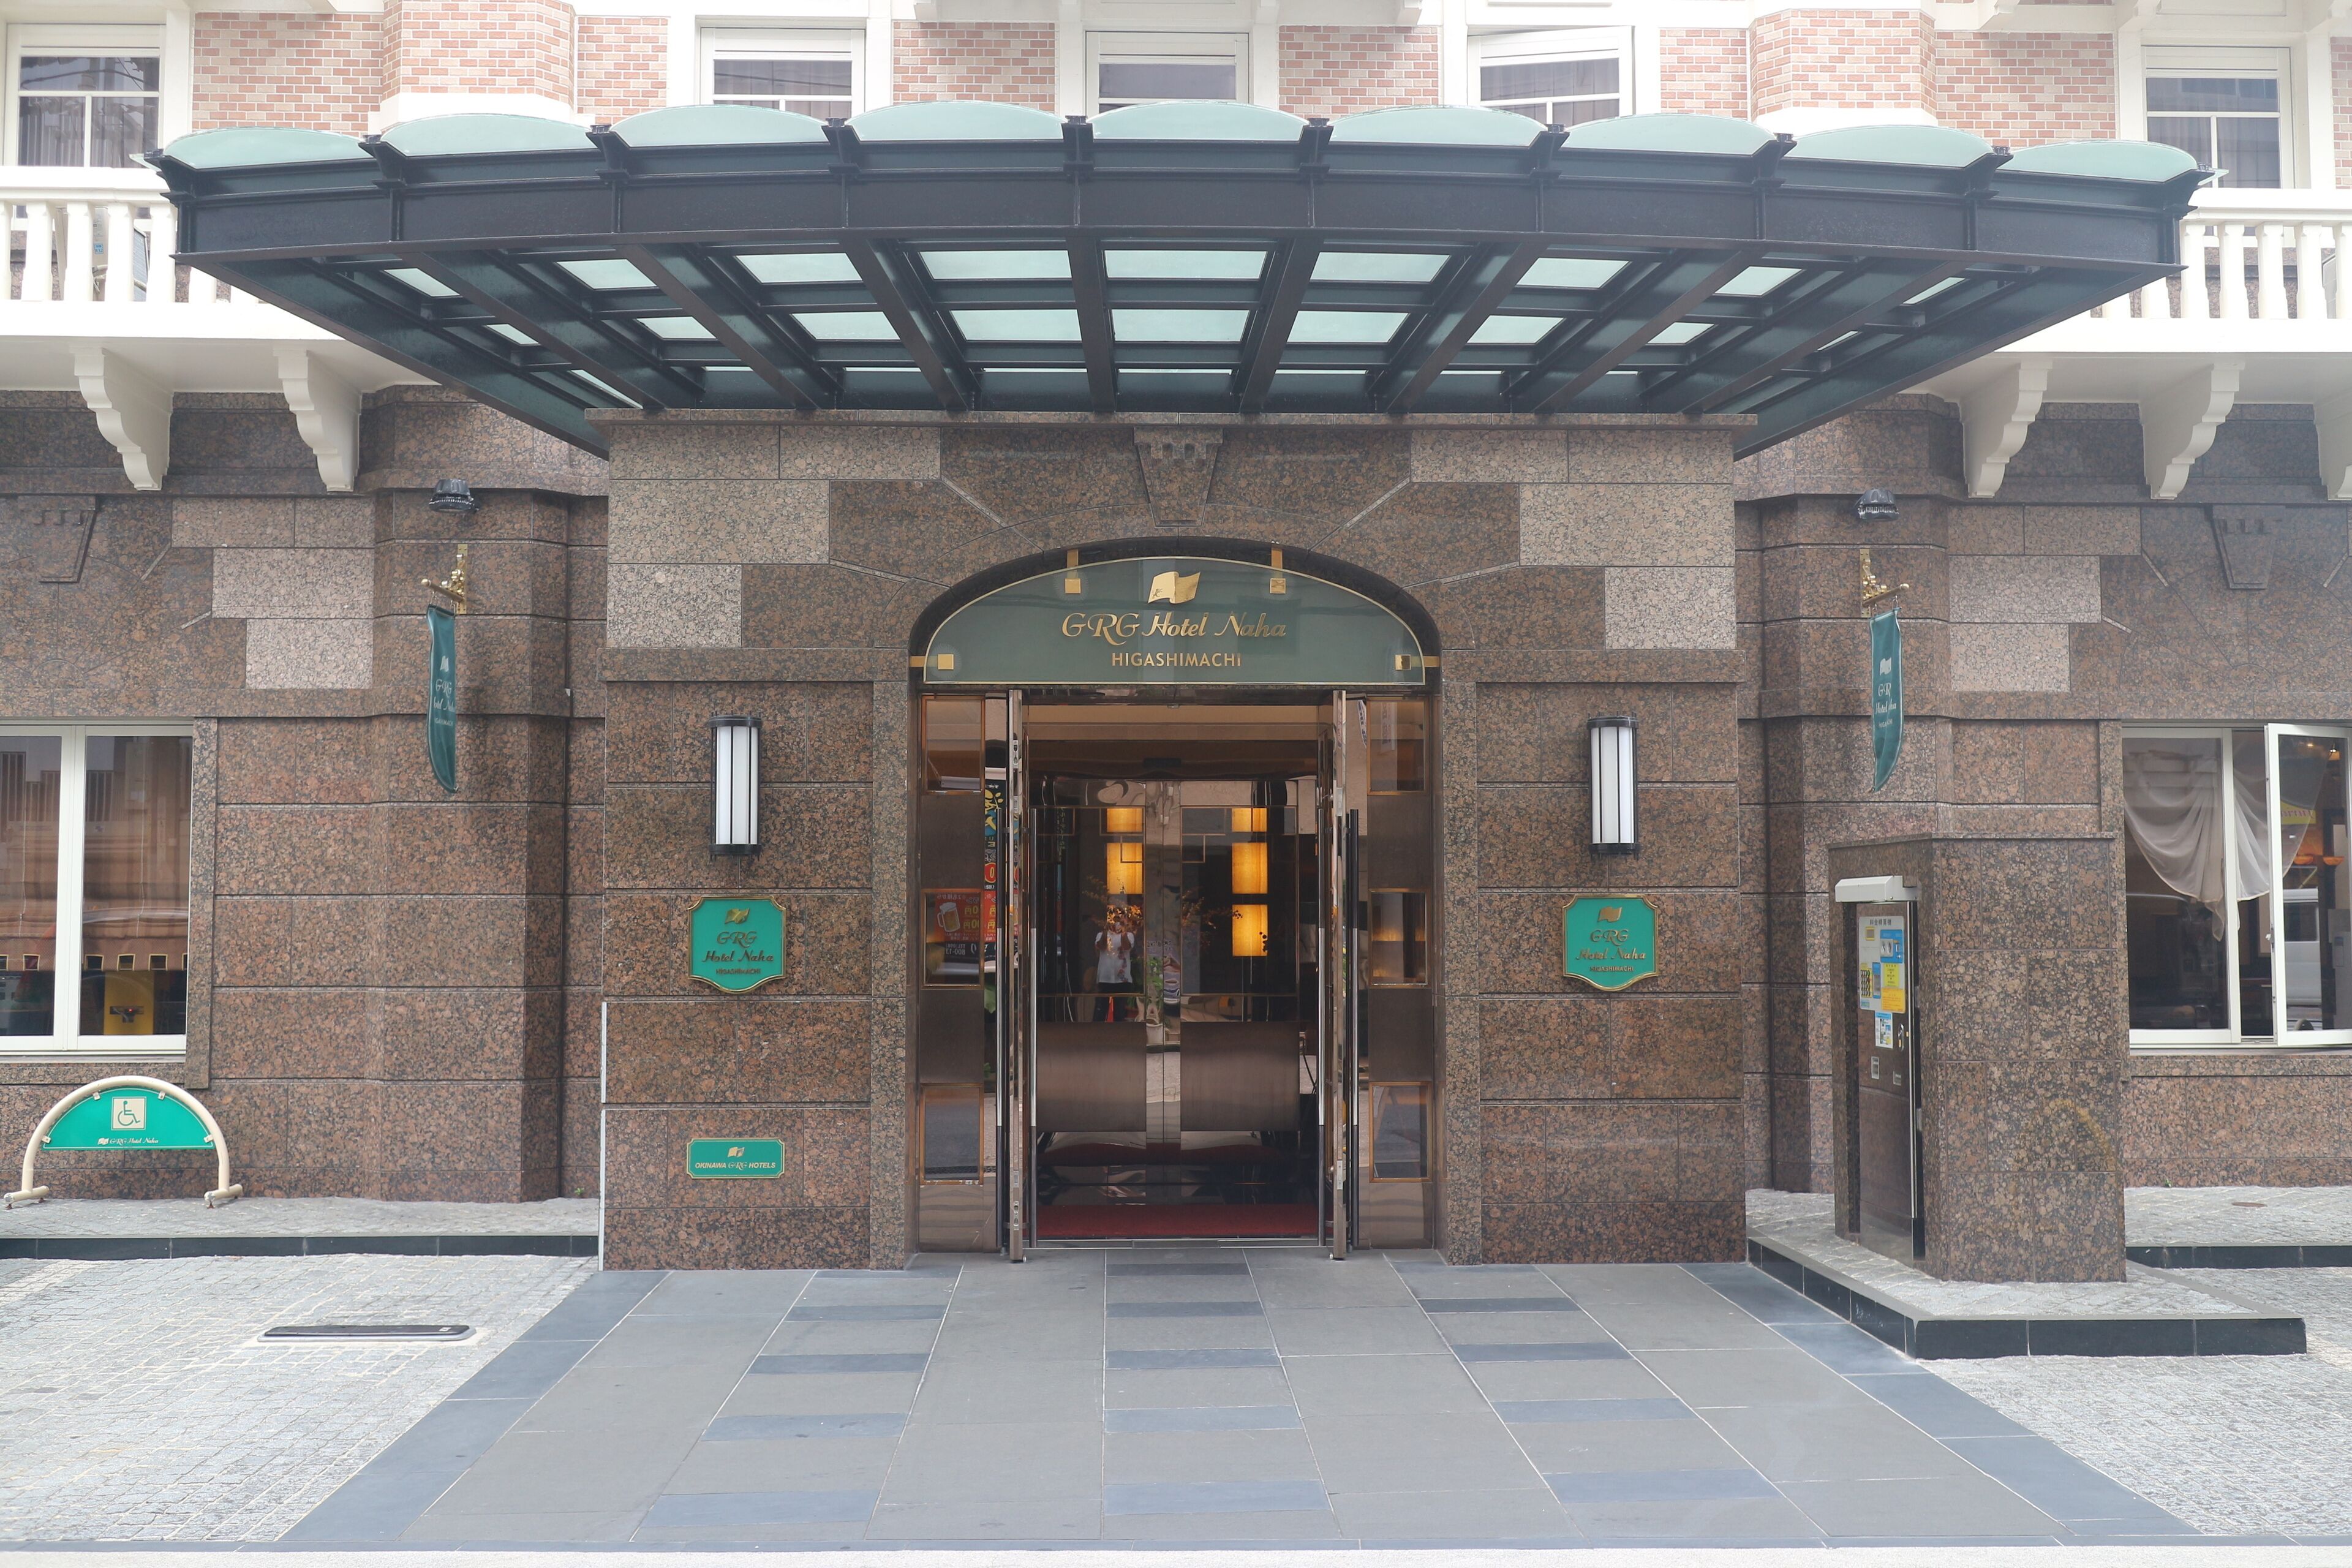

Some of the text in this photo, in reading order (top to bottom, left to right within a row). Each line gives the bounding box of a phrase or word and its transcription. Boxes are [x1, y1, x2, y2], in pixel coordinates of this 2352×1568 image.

[1061, 611, 1287, 646] GRG Hotel Naha
[1111, 652, 1242, 667] HIGASHIMACHI
[435, 679, 452, 698] GRG
[1878, 682, 1891, 698] GR
[717, 931, 758, 948] GRG
[1590, 929, 1629, 946] GRG
[702, 949, 774, 962] Hotel Naha
[1575, 948, 1646, 960] Hotel Naha
[728, 1161, 747, 1170] GRG
